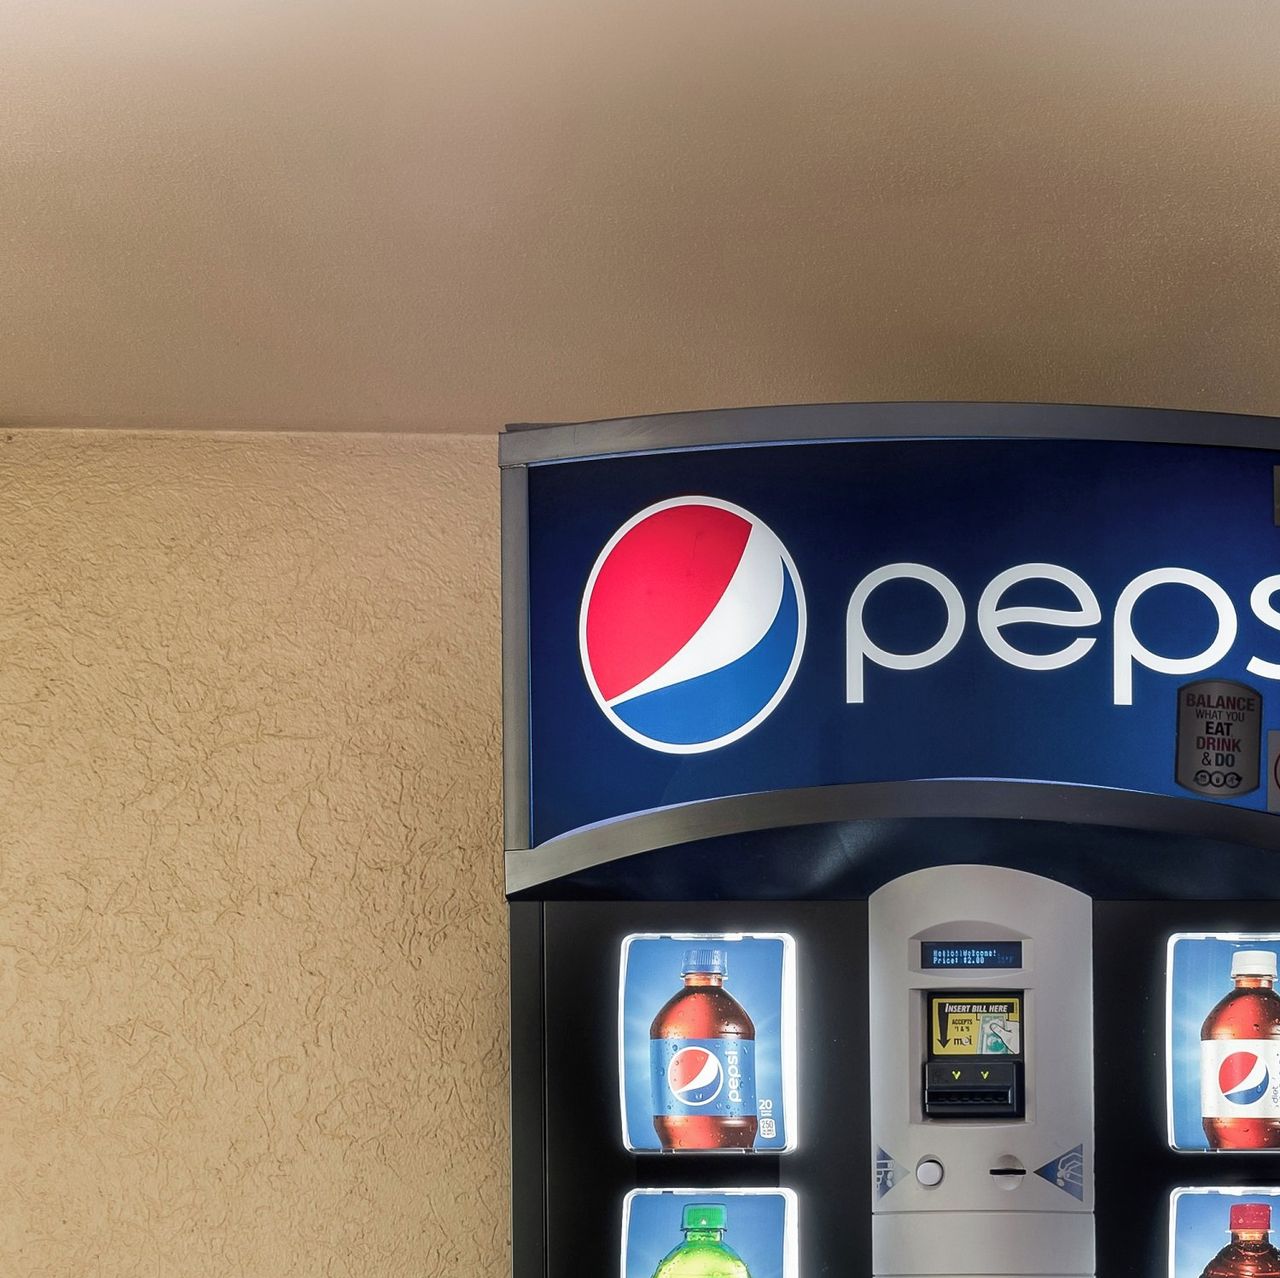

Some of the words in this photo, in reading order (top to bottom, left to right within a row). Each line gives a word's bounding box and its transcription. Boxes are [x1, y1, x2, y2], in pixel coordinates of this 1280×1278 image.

[1186, 693, 1254, 711] BALANCE
[1196, 709, 1223, 720] WHAT
[1226, 711, 1245, 722] YOU
[1206, 722, 1232, 736] EAT
[1196, 736, 1242, 752] DRINK
[1202, 752, 1211, 766] &
[1215, 753, 1235, 767] DO
[945, 1003, 971, 1012] INSERT
[972, 1004, 987, 1012] BILL
[989, 1004, 1008, 1012] HERE
[725, 1051, 741, 1102] pepsi
[759, 1099, 772, 1110] 20
